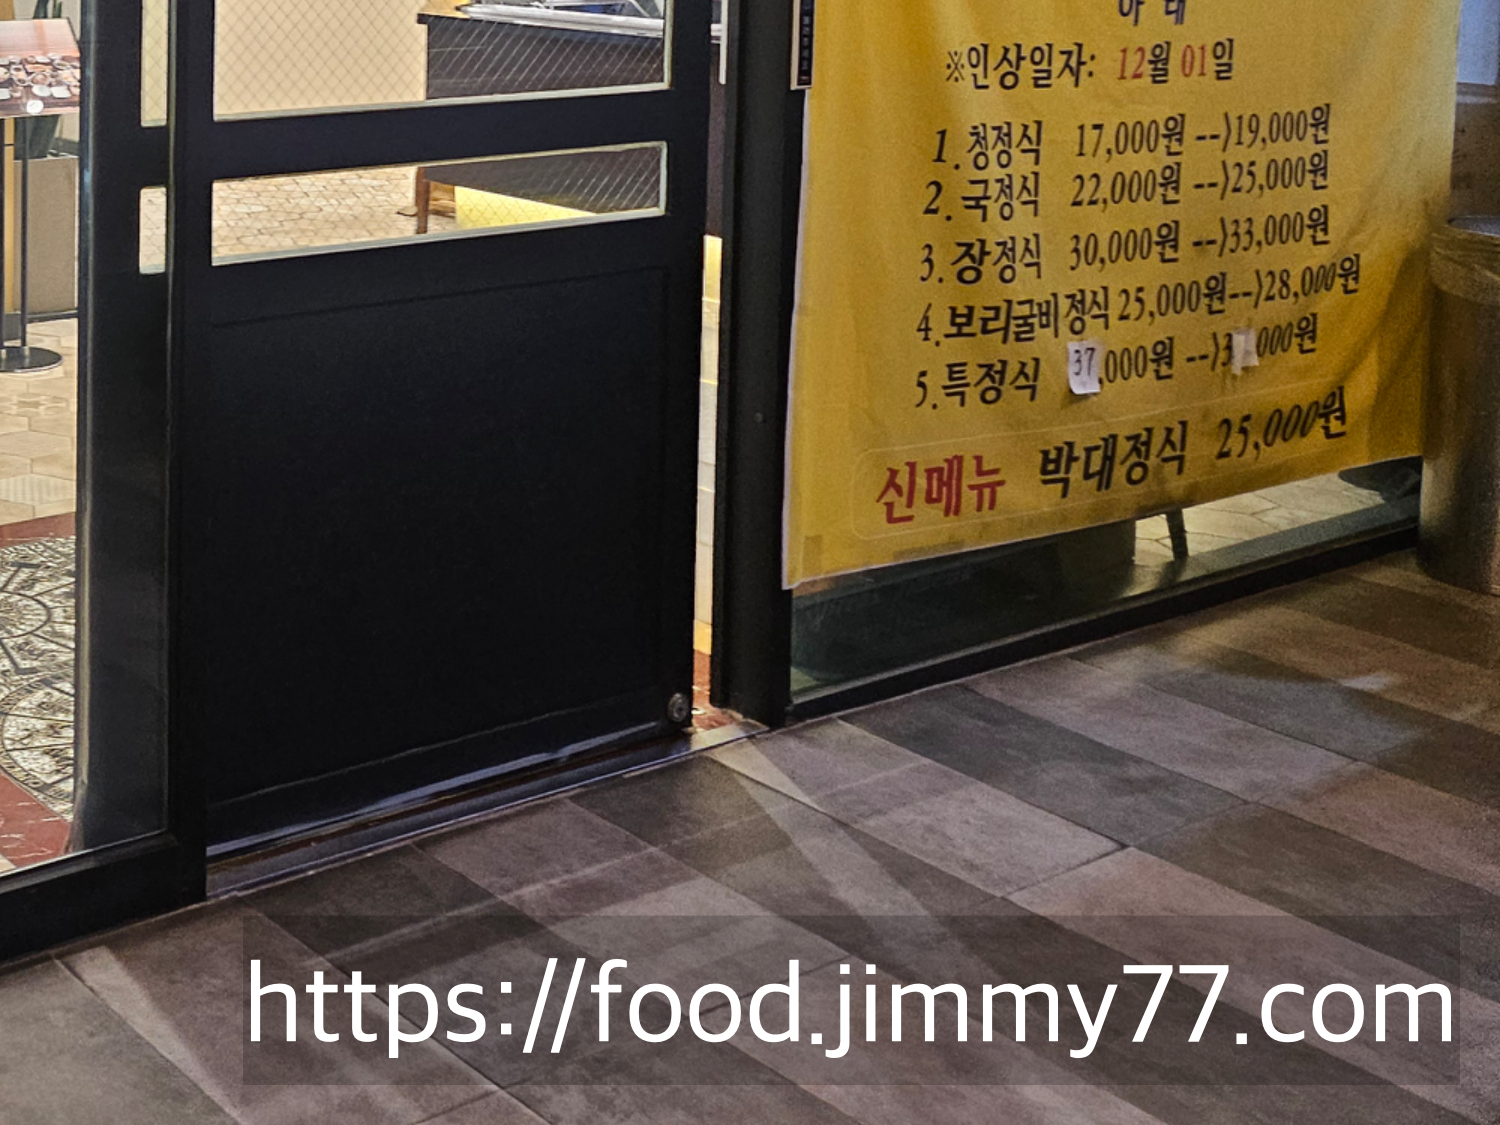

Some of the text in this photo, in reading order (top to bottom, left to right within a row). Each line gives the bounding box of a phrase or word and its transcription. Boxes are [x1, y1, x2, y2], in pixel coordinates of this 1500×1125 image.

[1116, 40, 1171, 84] 12월
[1181, 38, 1235, 81] 01일
[1074, 113, 1187, 161] 17,000원
[1070, 161, 1182, 212] 22,000원
[1069, 220, 1180, 273] 30,000원
[876, 385, 1347, 525] 신메뉴 박대정식 25,000원
